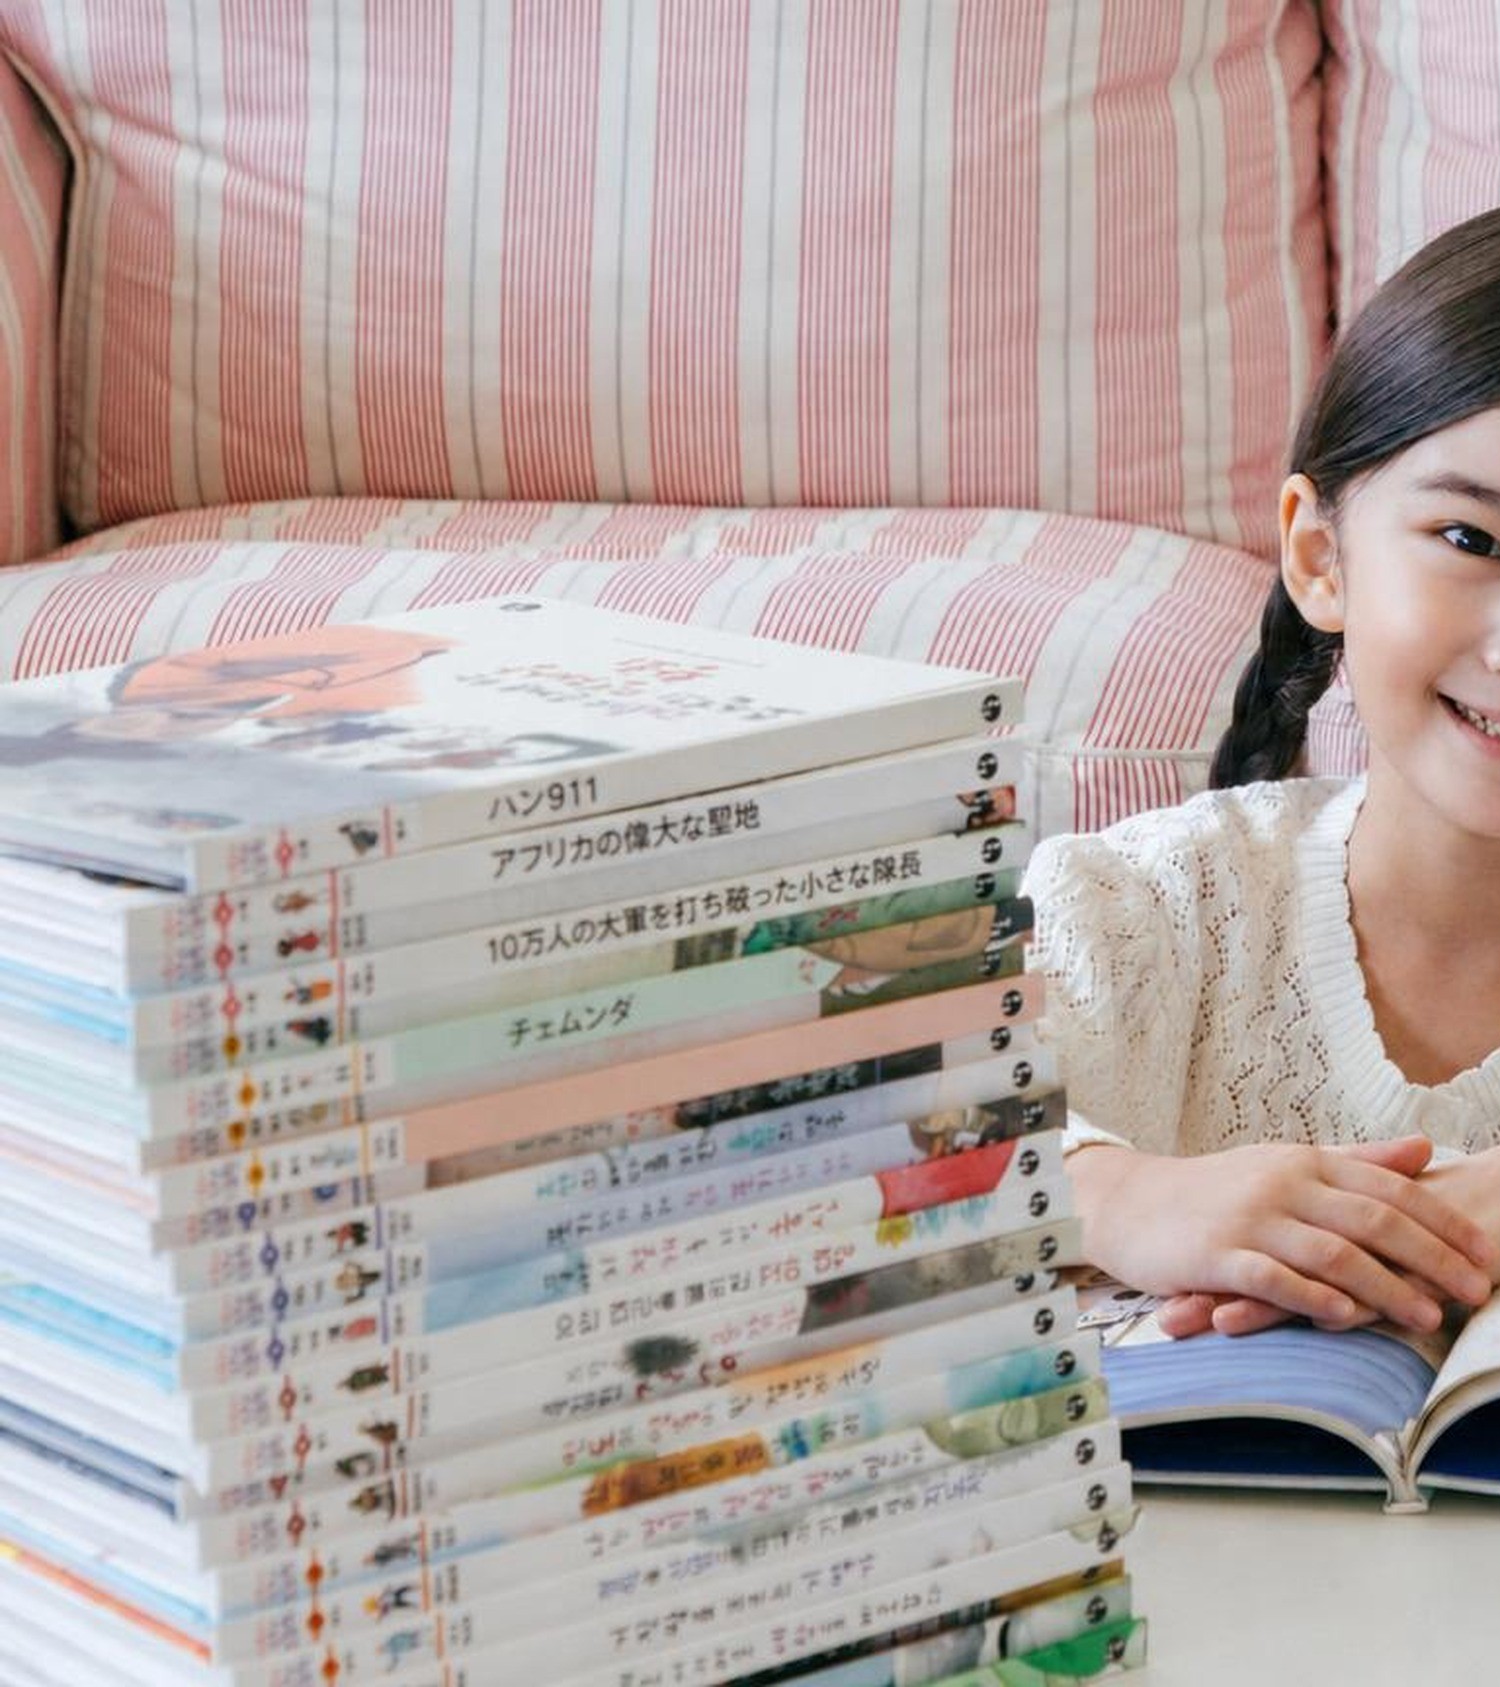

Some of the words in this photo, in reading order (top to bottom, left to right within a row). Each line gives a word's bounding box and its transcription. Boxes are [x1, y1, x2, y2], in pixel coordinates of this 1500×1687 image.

[489, 778, 598, 820] ハン911
[492, 803, 760, 877] アフリカの偉大な聖地
[489, 852, 922, 962] 10万人の大軍を打ち破った小さな隊長
[509, 998, 632, 1047] チェムンダ
[760, 1258, 800, 1285] 꼬마
[813, 1244, 856, 1272] 대장
